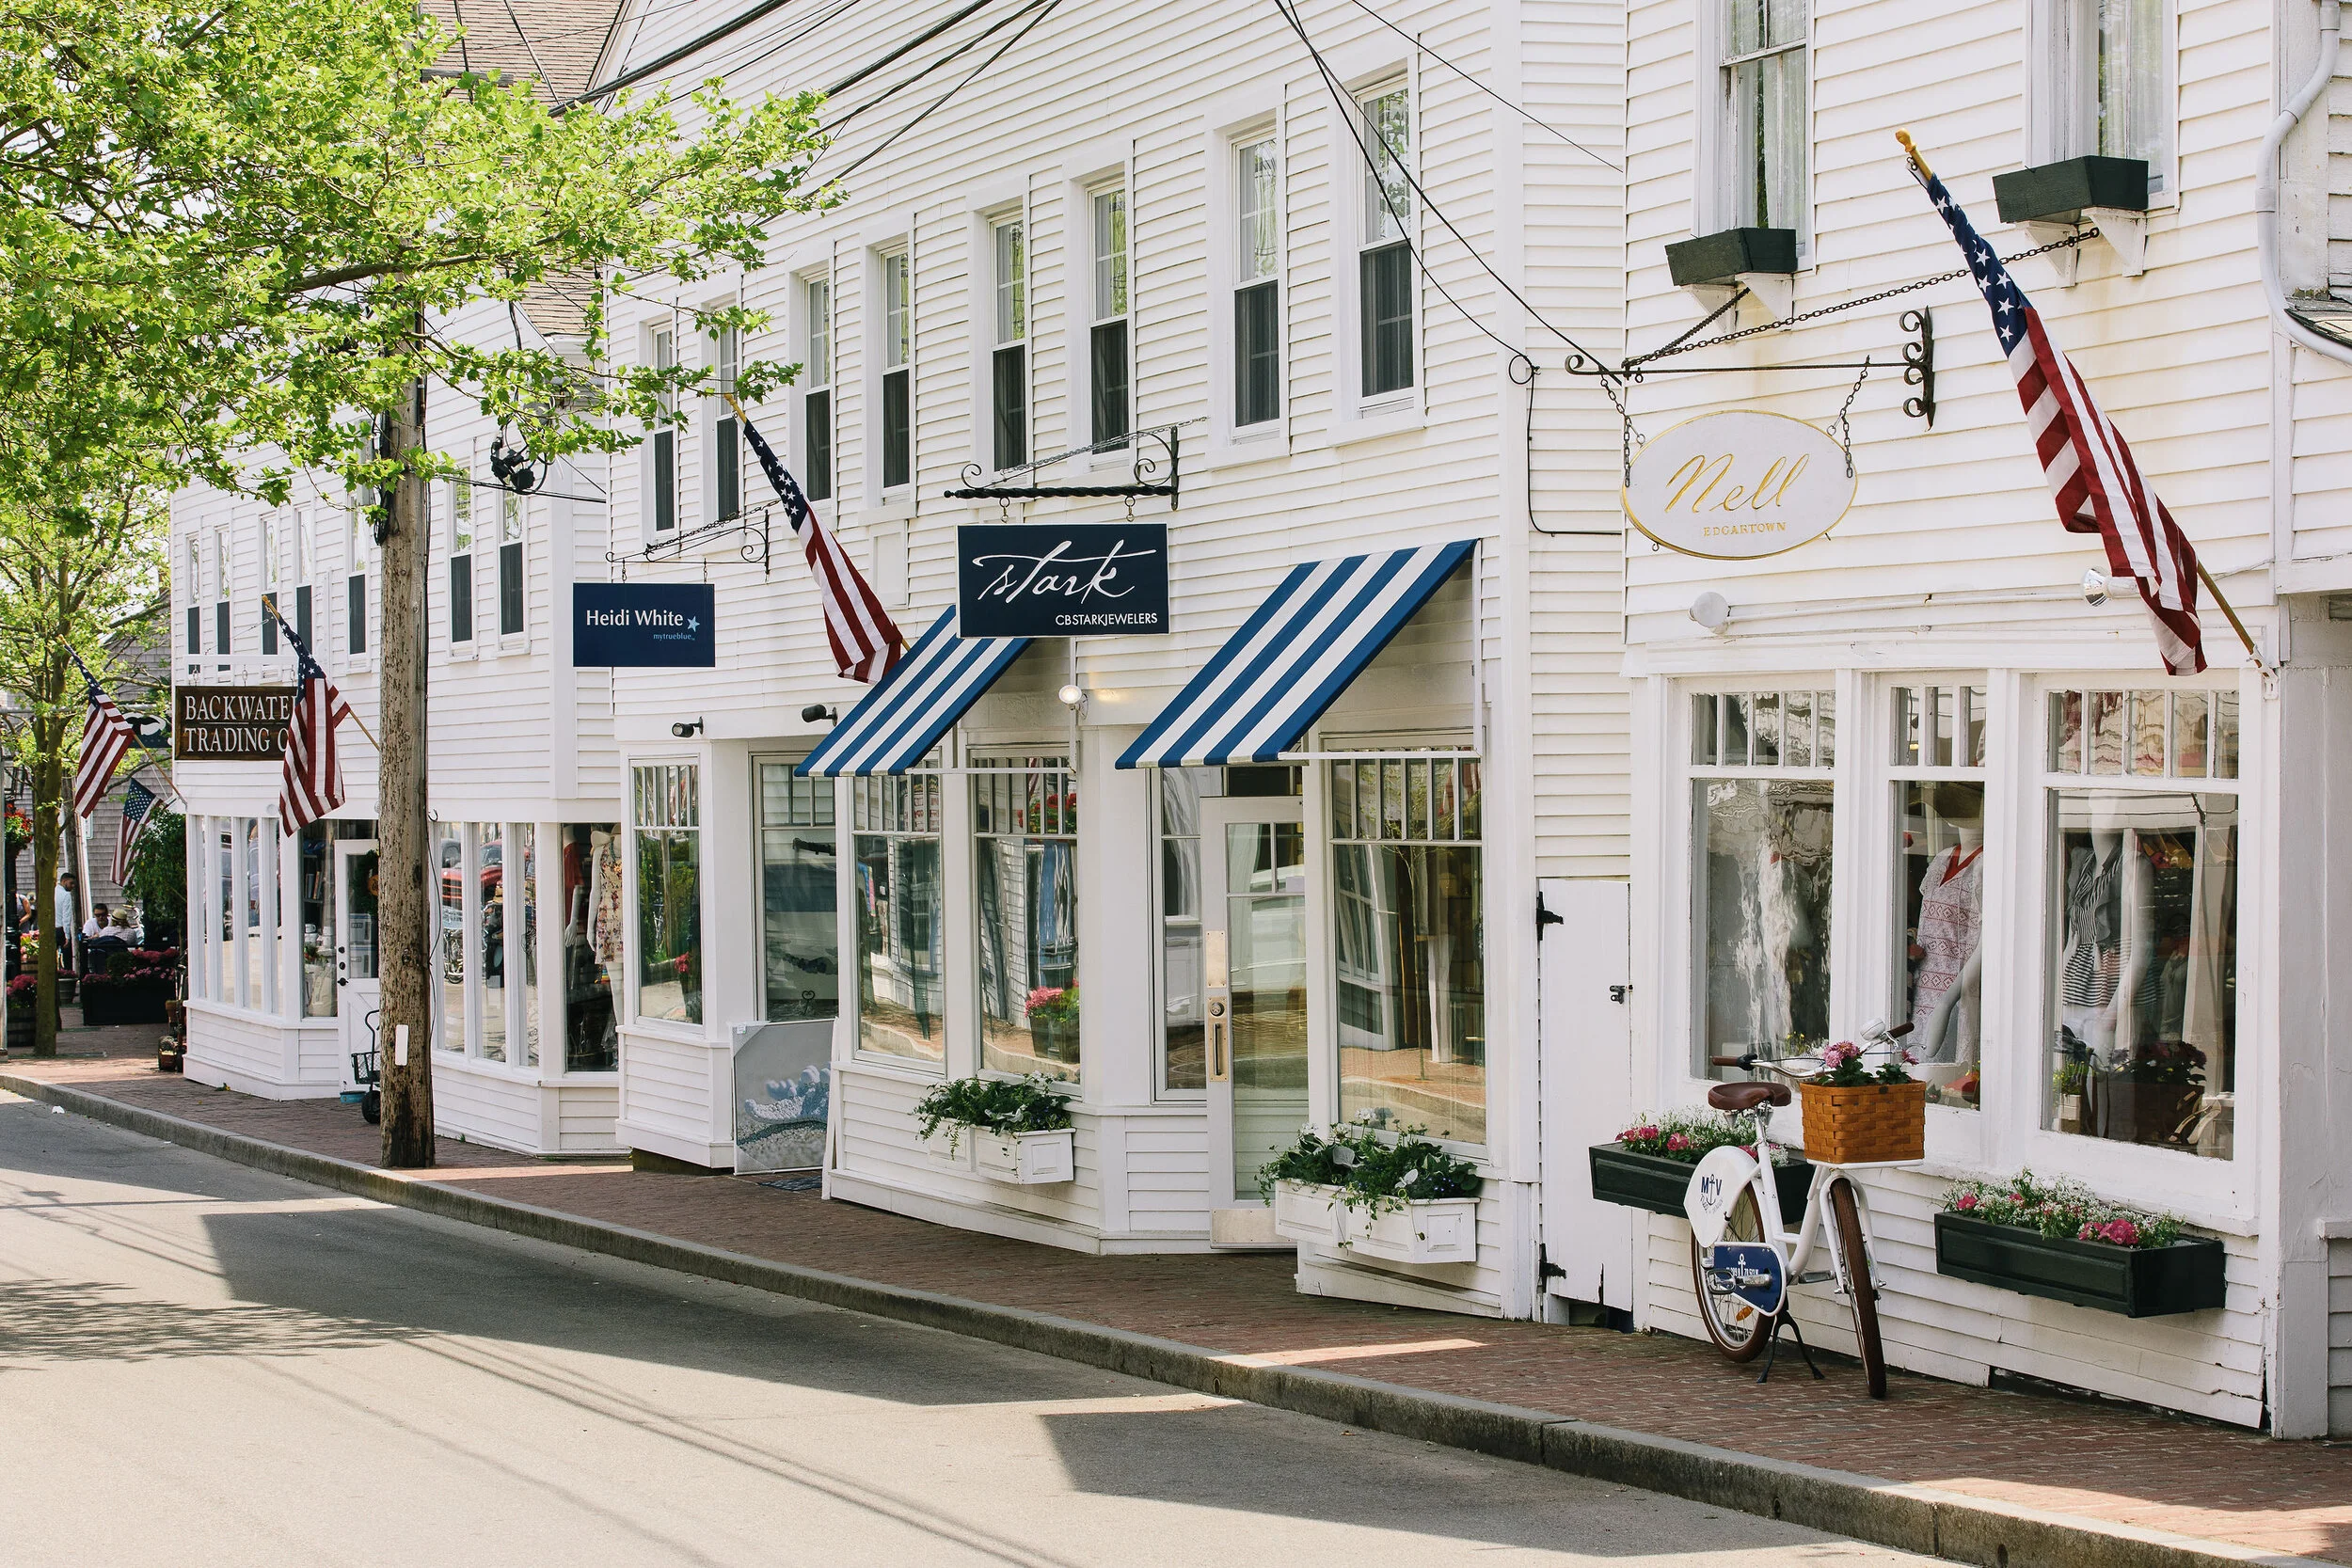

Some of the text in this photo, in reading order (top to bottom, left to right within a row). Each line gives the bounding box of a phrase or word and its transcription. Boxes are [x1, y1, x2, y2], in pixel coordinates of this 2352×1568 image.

[1664, 453, 1810, 513] Nell
[1703, 521, 1788, 537] EDGARTOWN
[972, 539, 1157, 605] stark
[586, 609, 684, 626] Heidi White
[1055, 612, 1158, 626] CBSTARKJEWELERS
[653, 632, 691, 641] mytrueblue
[183, 726, 271, 752] TRADING
